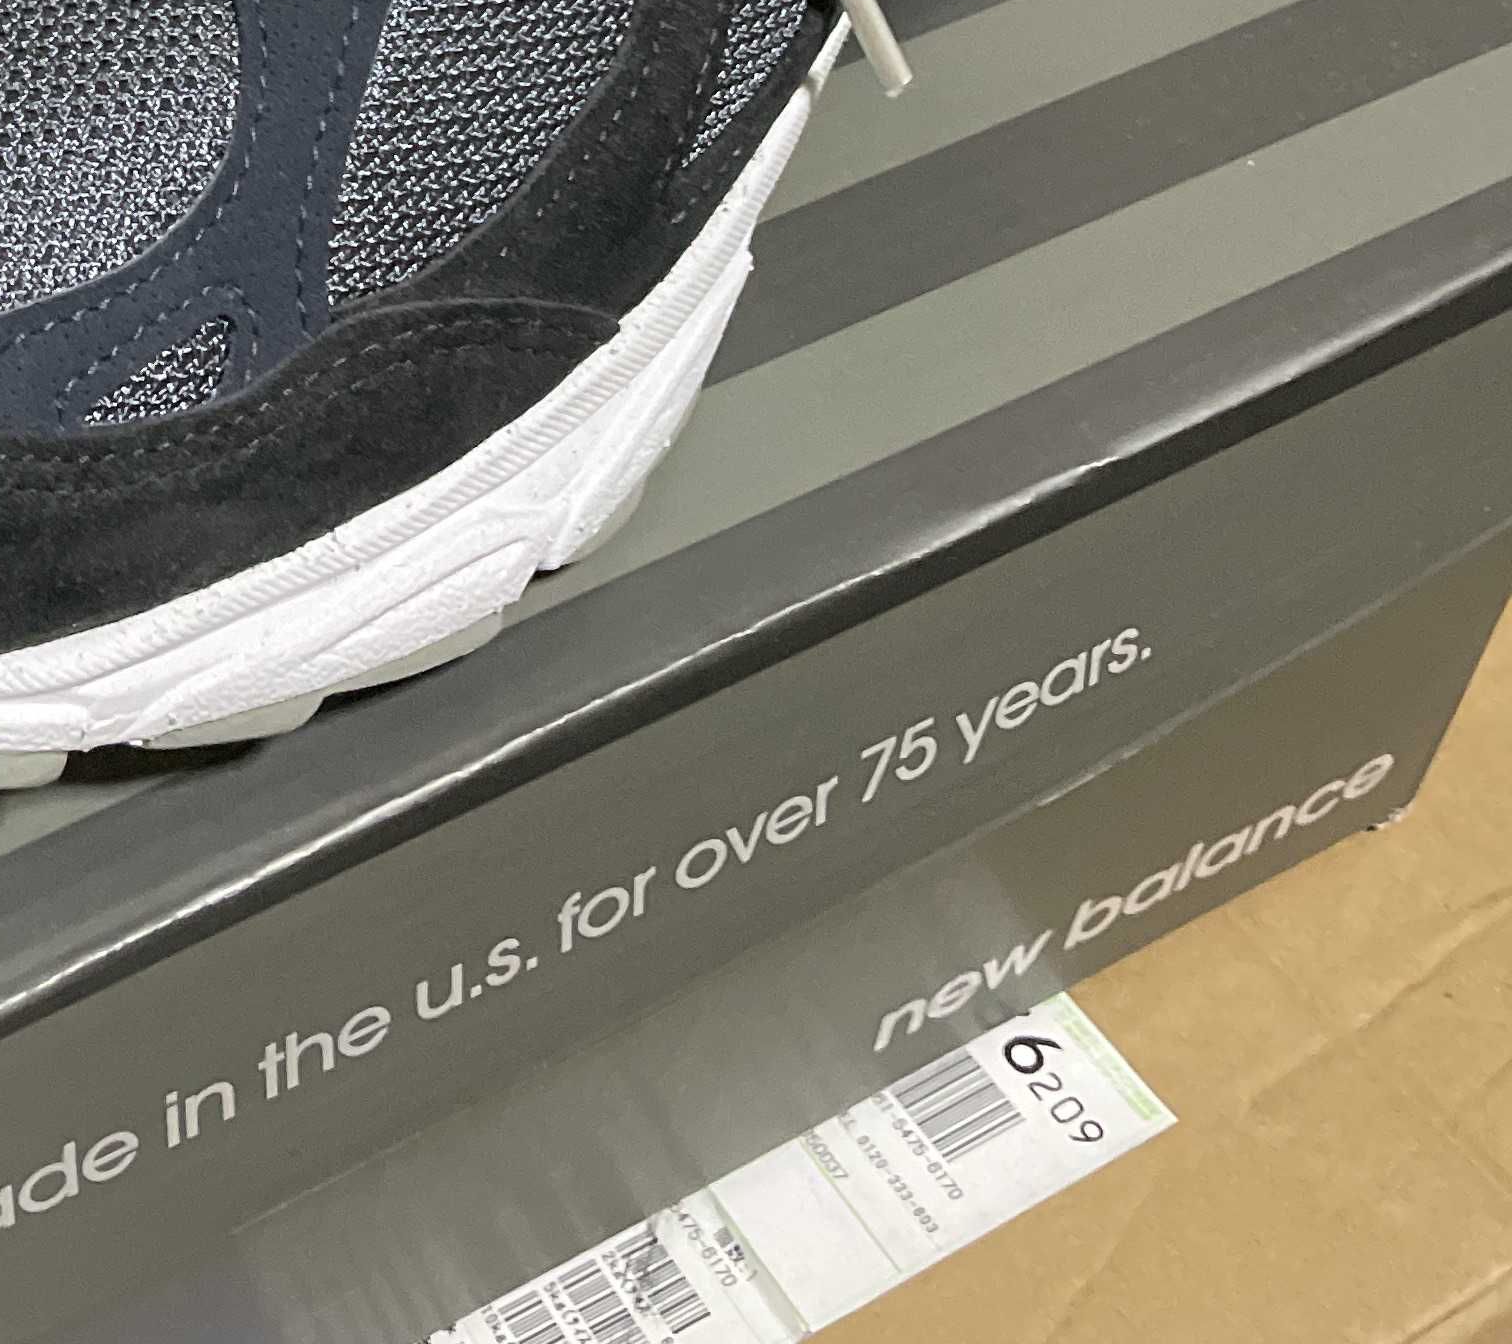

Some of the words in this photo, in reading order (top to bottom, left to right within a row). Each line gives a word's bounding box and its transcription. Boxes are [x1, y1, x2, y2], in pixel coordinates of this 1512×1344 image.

[164, 1080, 236, 1149] in
[258, 1005, 390, 1100] the
[415, 936, 540, 1022] u.s.
[556, 867, 659, 953] for
[675, 775, 842, 891] over
[857, 717, 938, 805] 75
[955, 625, 1153, 766] years.
[871, 928, 1054, 1053] new
[1061, 751, 1395, 949] balance
